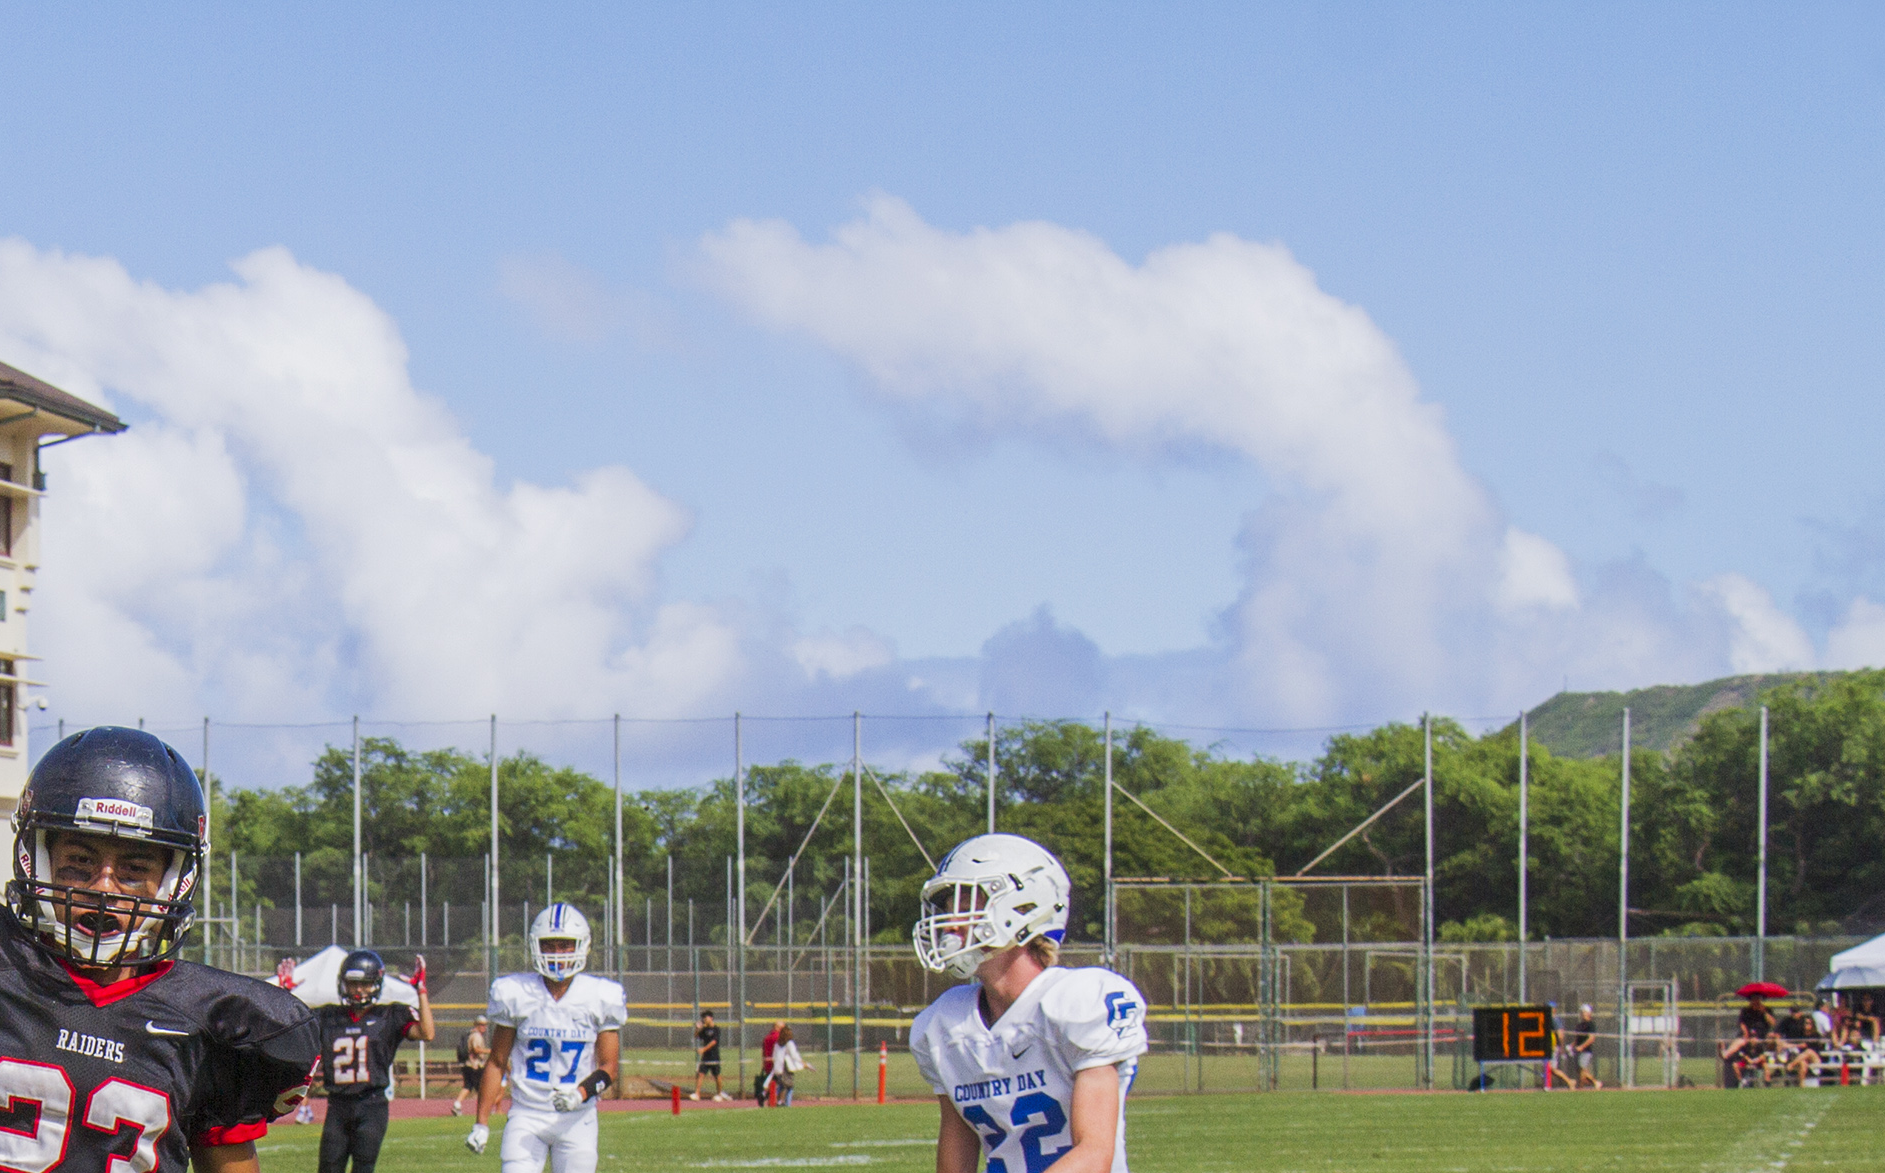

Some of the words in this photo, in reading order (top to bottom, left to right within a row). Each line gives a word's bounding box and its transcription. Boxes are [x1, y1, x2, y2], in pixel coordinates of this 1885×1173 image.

[96, 802, 137, 818] Riddell
[56, 1028, 125, 1064] RAIDERS
[528, 1026, 567, 1038] COUNTRY
[571, 1029, 587, 1039] DAY
[1502, 1011, 1545, 1058] 12
[333, 1035, 370, 1085] 21
[526, 1038, 587, 1084] 27
[954, 1077, 1011, 1102] COUNTRY
[1016, 1069, 1047, 1092] DAY
